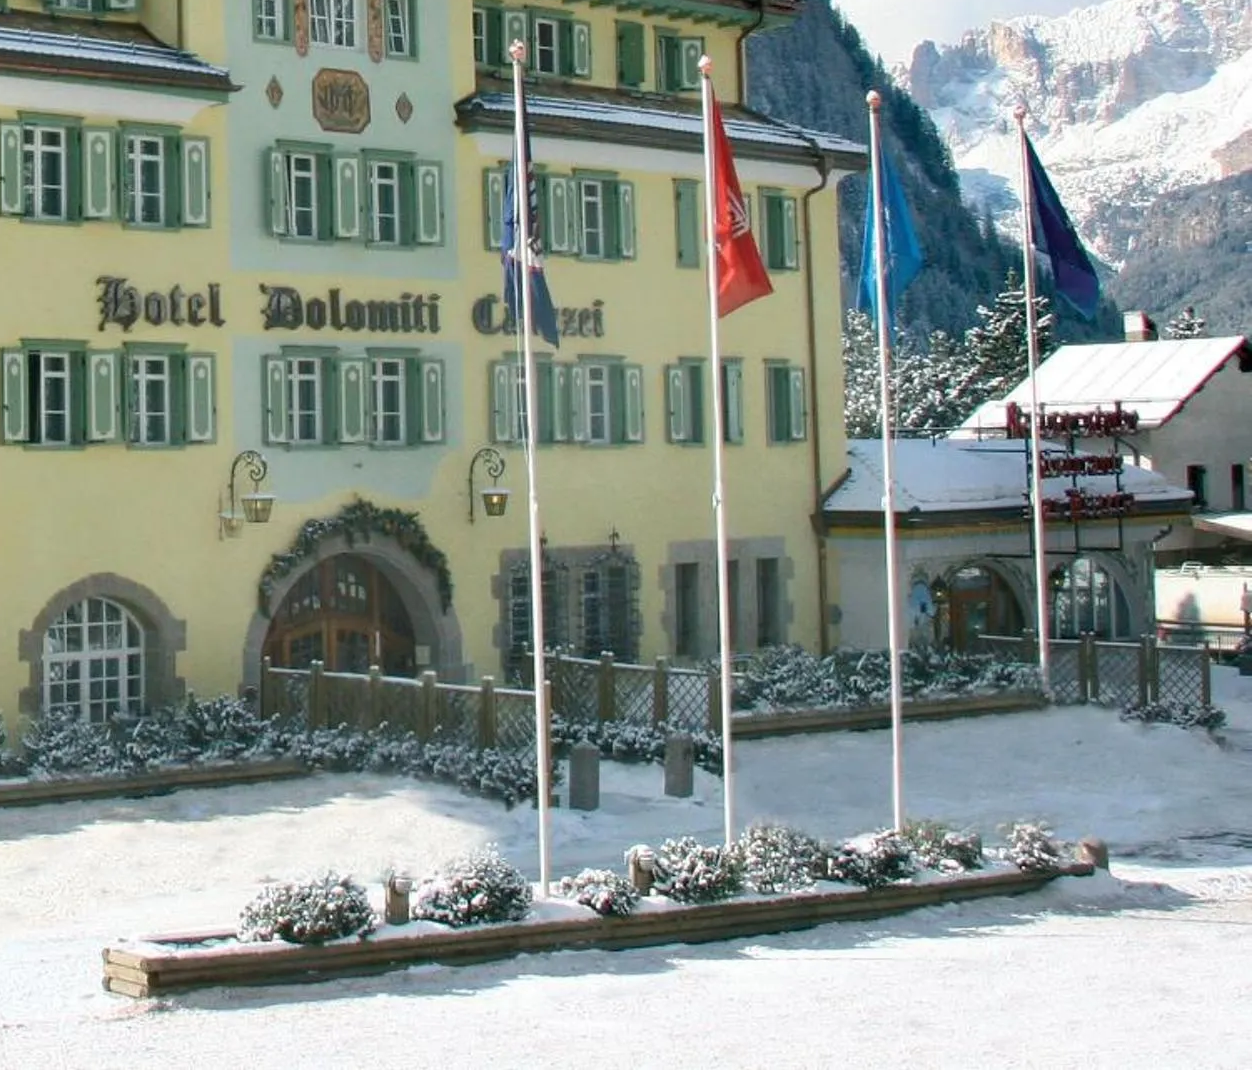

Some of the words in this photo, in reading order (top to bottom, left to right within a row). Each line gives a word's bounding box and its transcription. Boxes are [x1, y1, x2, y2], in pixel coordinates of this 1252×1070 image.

[97, 275, 226, 331] Hotel
[259, 283, 441, 334] Dolomiti
[471, 293, 605, 338] Cazei
